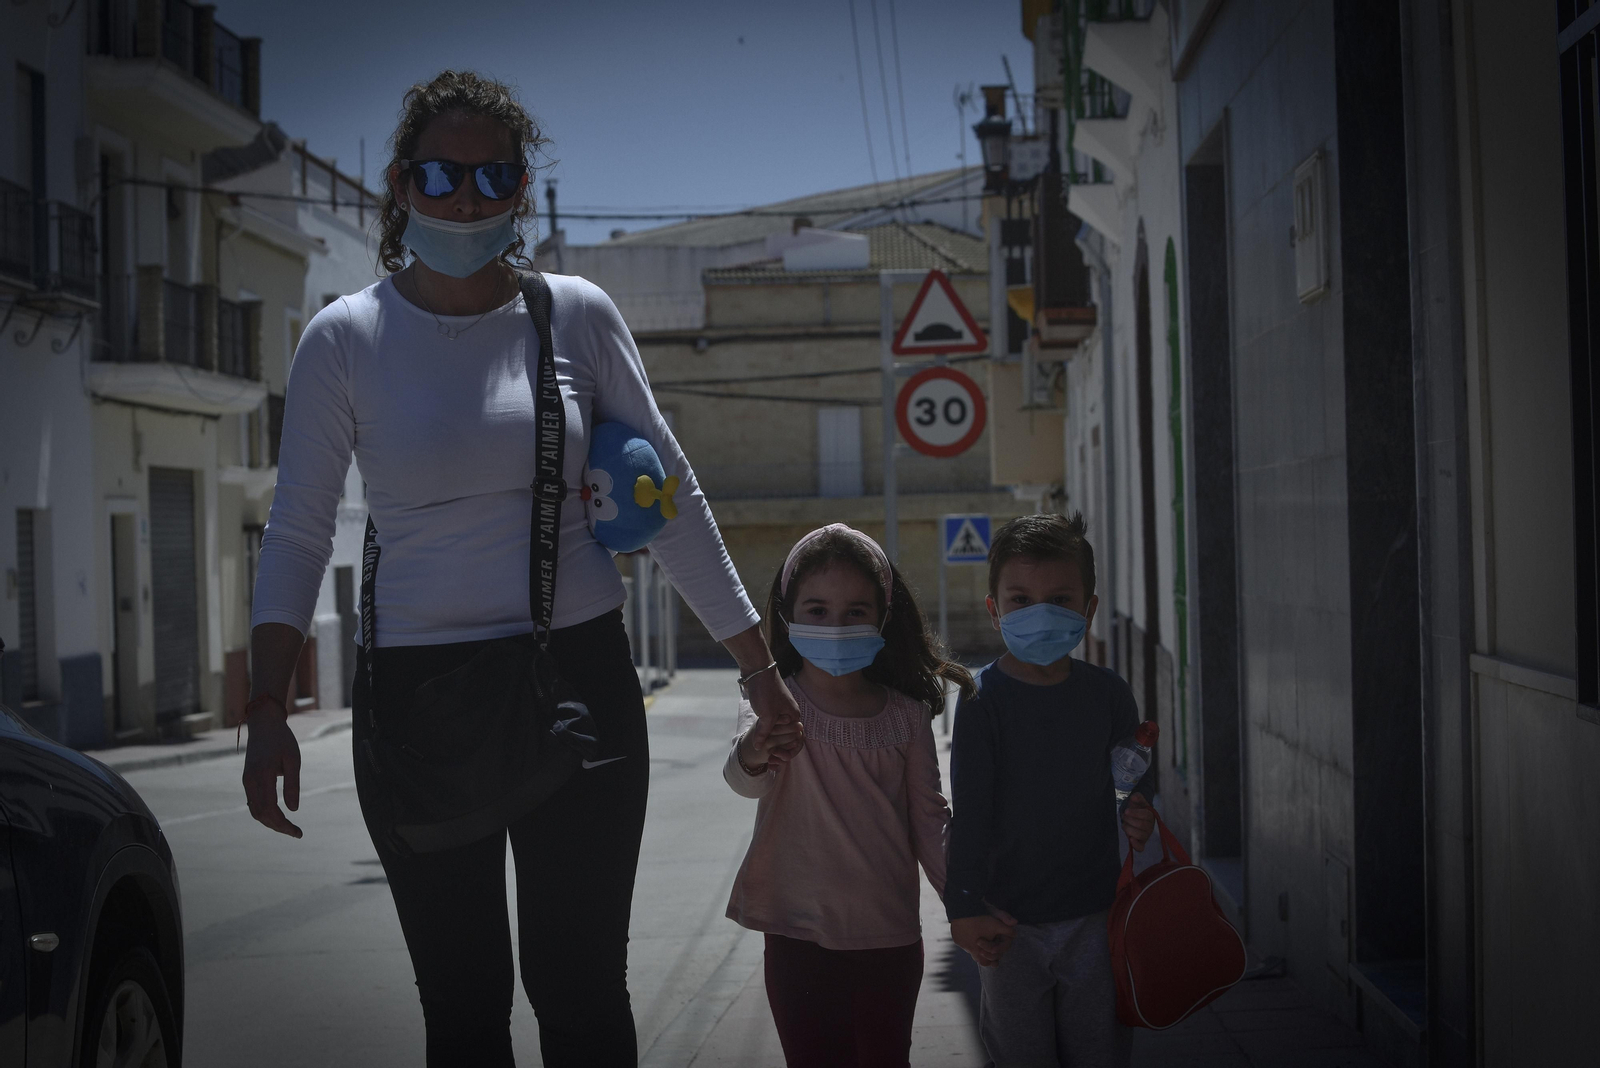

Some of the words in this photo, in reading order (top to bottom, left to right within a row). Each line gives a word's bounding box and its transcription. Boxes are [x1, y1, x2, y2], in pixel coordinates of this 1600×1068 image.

[915, 397, 966, 425] 30
[541, 411, 559, 476] J'AIMER
[362, 593, 372, 654] J'AIMER
[540, 559, 553, 626] J'AIMER
